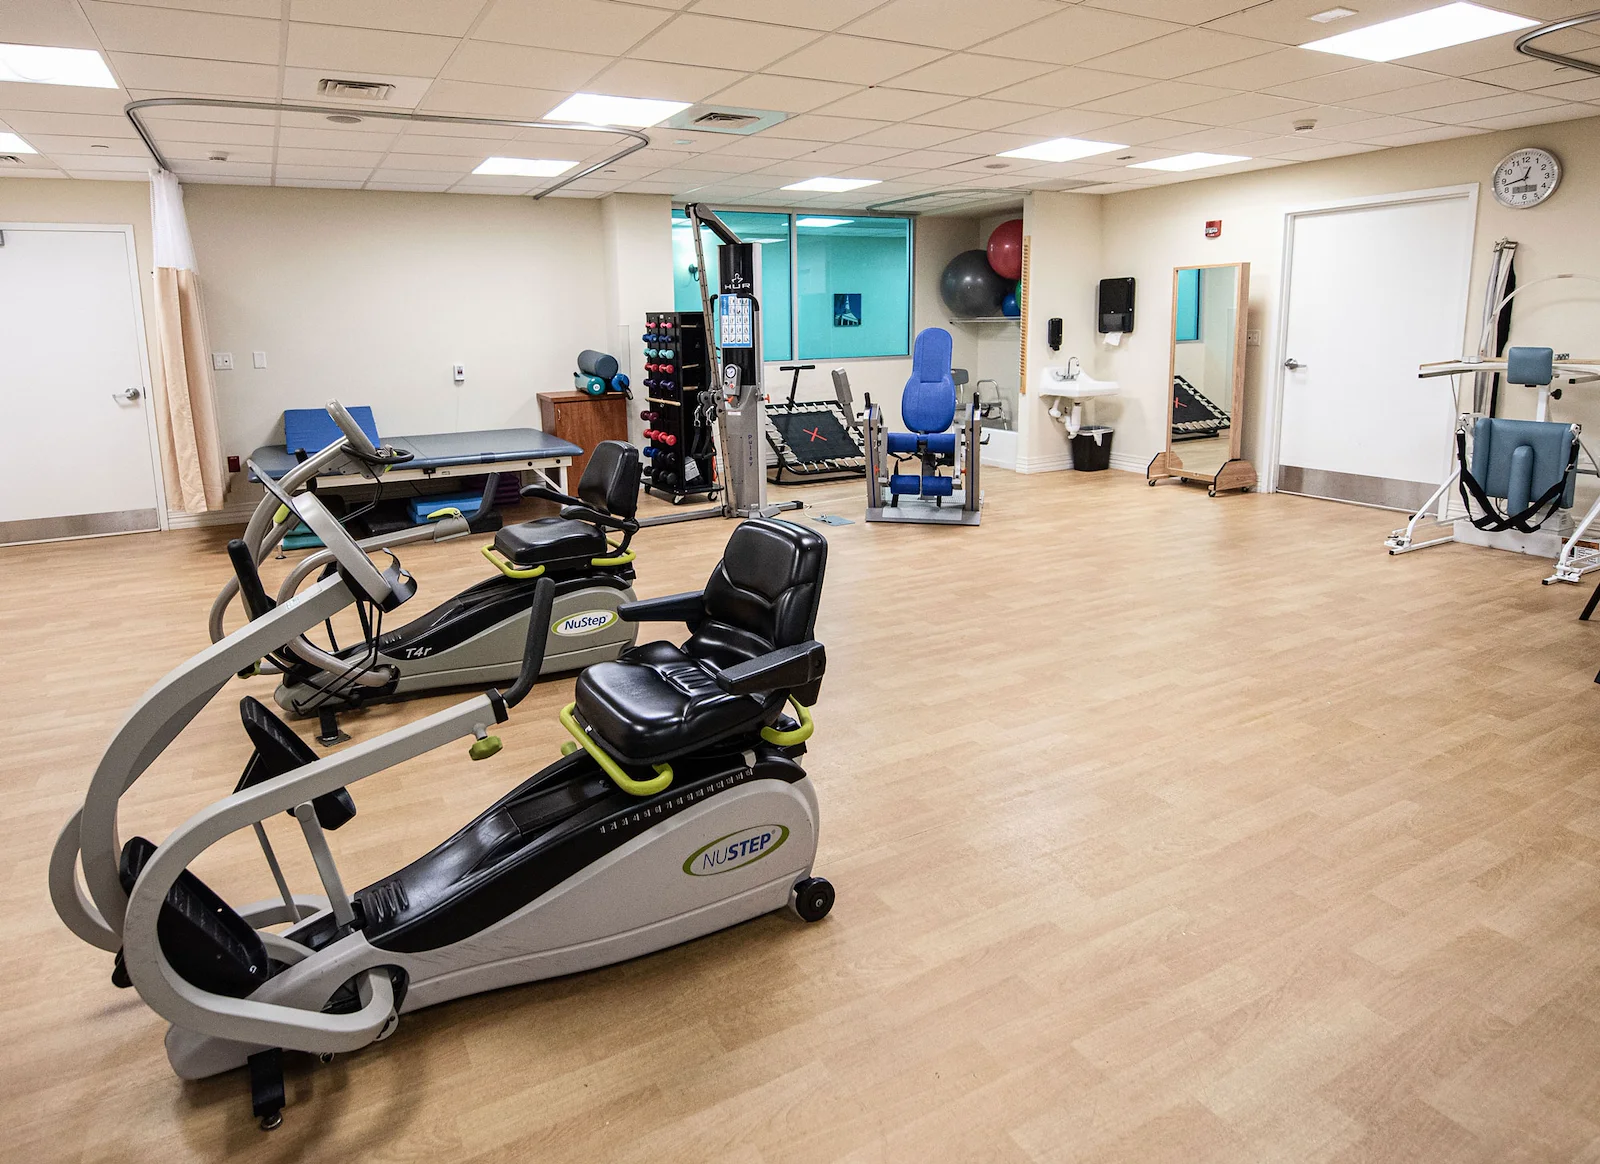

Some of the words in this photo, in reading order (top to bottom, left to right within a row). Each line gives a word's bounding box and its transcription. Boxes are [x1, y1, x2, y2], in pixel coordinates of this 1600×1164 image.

[1504, 168, 1513, 176] 10
[1541, 163, 1547, 171] 2
[724, 282, 751, 290] HUR
[564, 615, 607, 630] NuStep
[405, 646, 433, 659] T4r
[702, 832, 772, 870] NUSTEP
